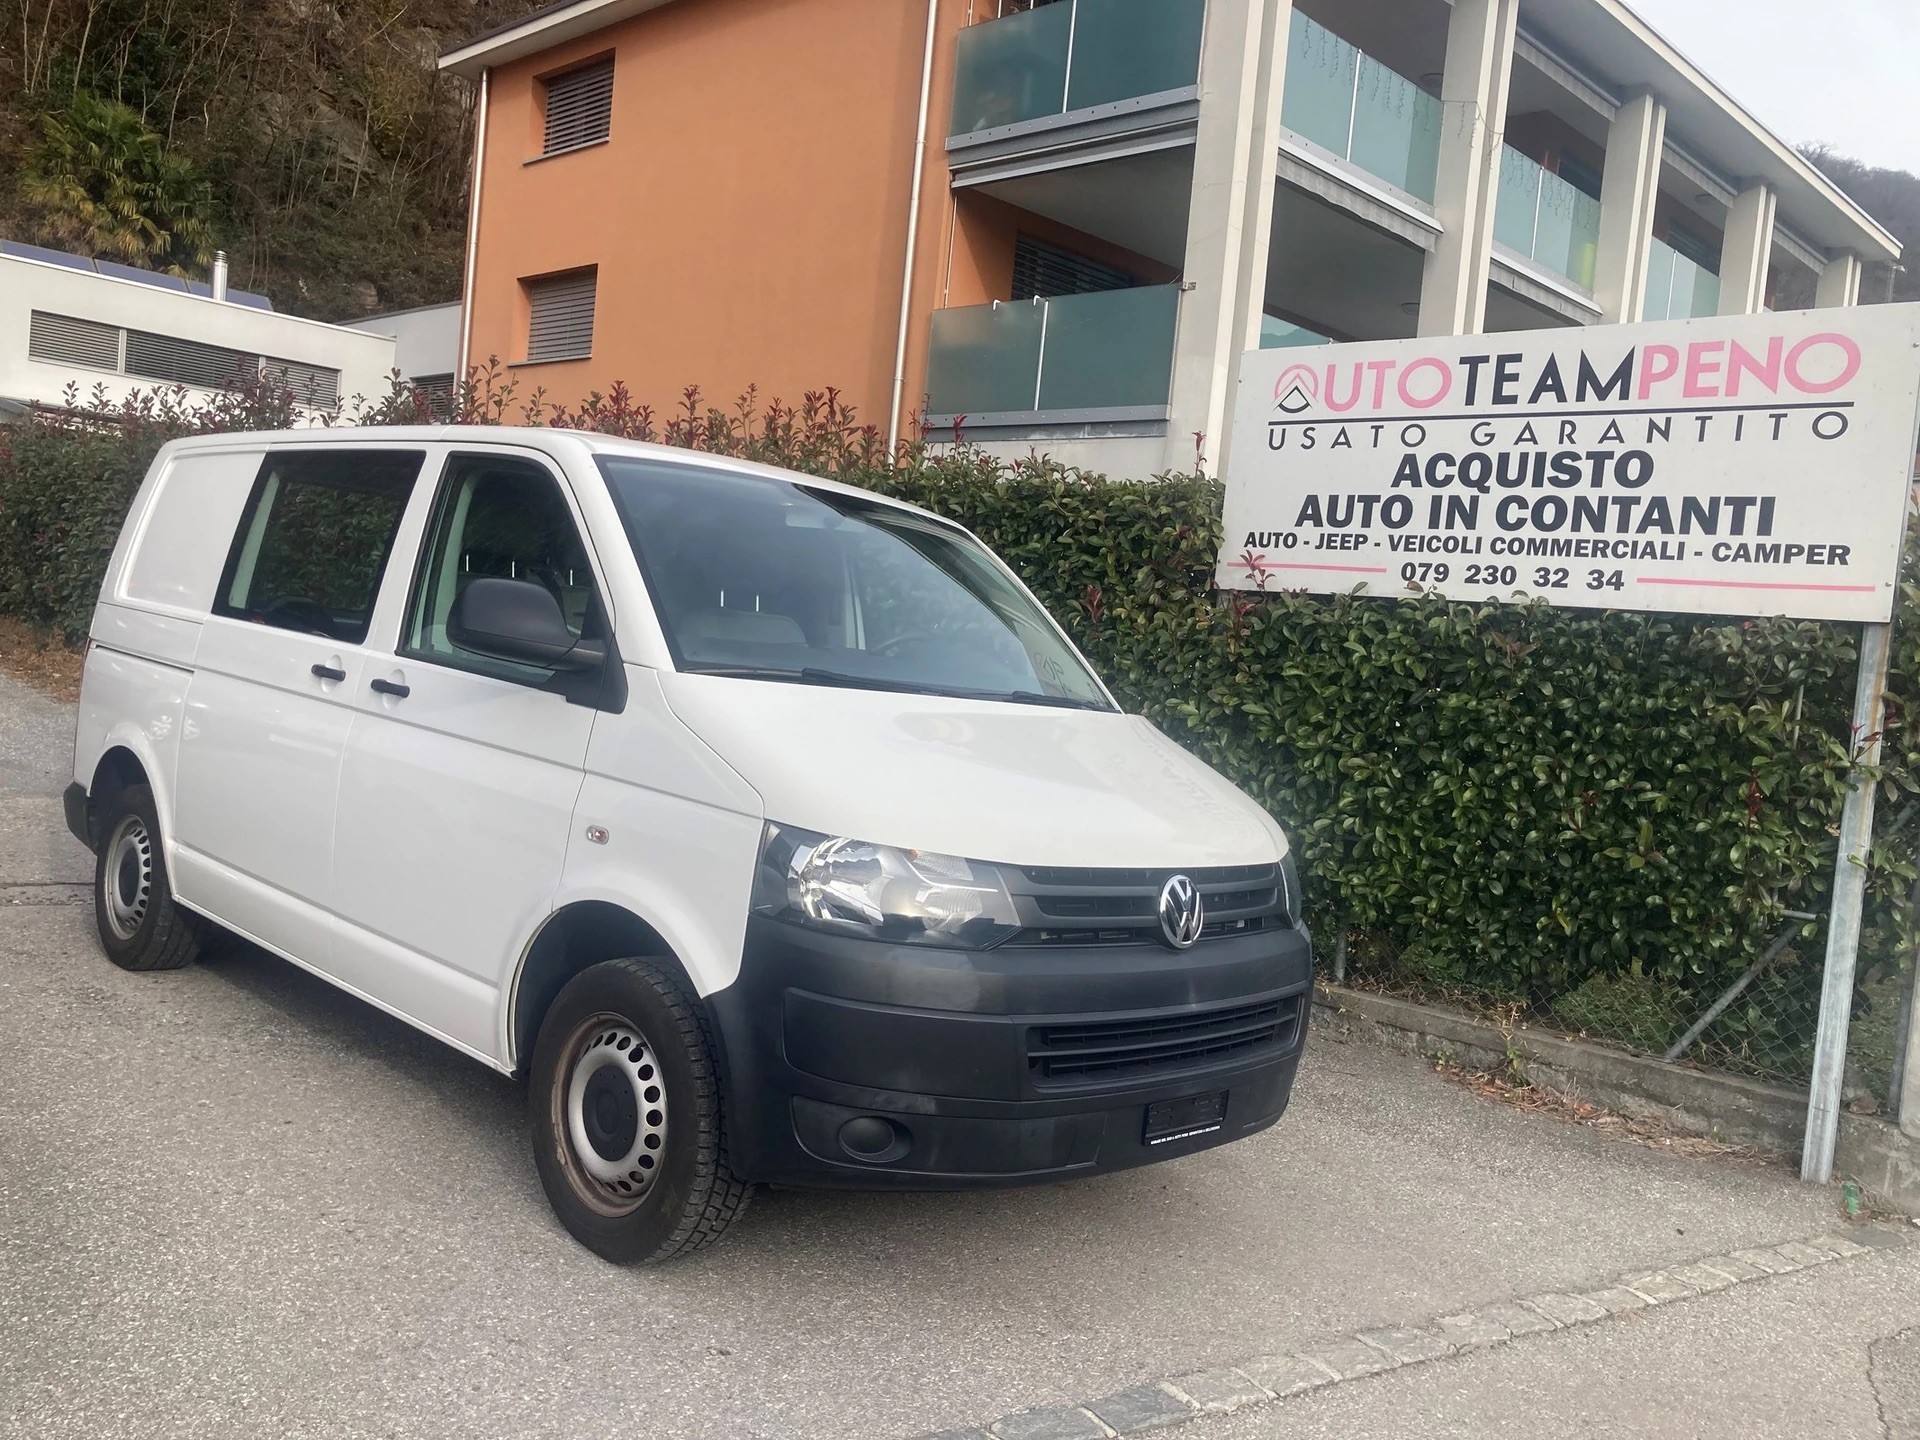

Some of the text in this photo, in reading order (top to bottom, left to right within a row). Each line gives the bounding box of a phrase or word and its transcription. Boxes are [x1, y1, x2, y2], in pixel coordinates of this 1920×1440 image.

[1268, 411, 1849, 450] USATO GARANTITO
[1390, 449, 1655, 494] ACQUISTO
[1294, 494, 1776, 536] AUTO IN CONTANTI
[1243, 532, 1298, 549] AUTO
[1315, 533, 1369, 551] JEEP
[1388, 534, 1482, 554] VEICOLI
[1489, 536, 1685, 561] COMMERCIALI
[1711, 542, 1851, 566] CAMPER
[1401, 562, 1625, 591] 079 230 32 34
